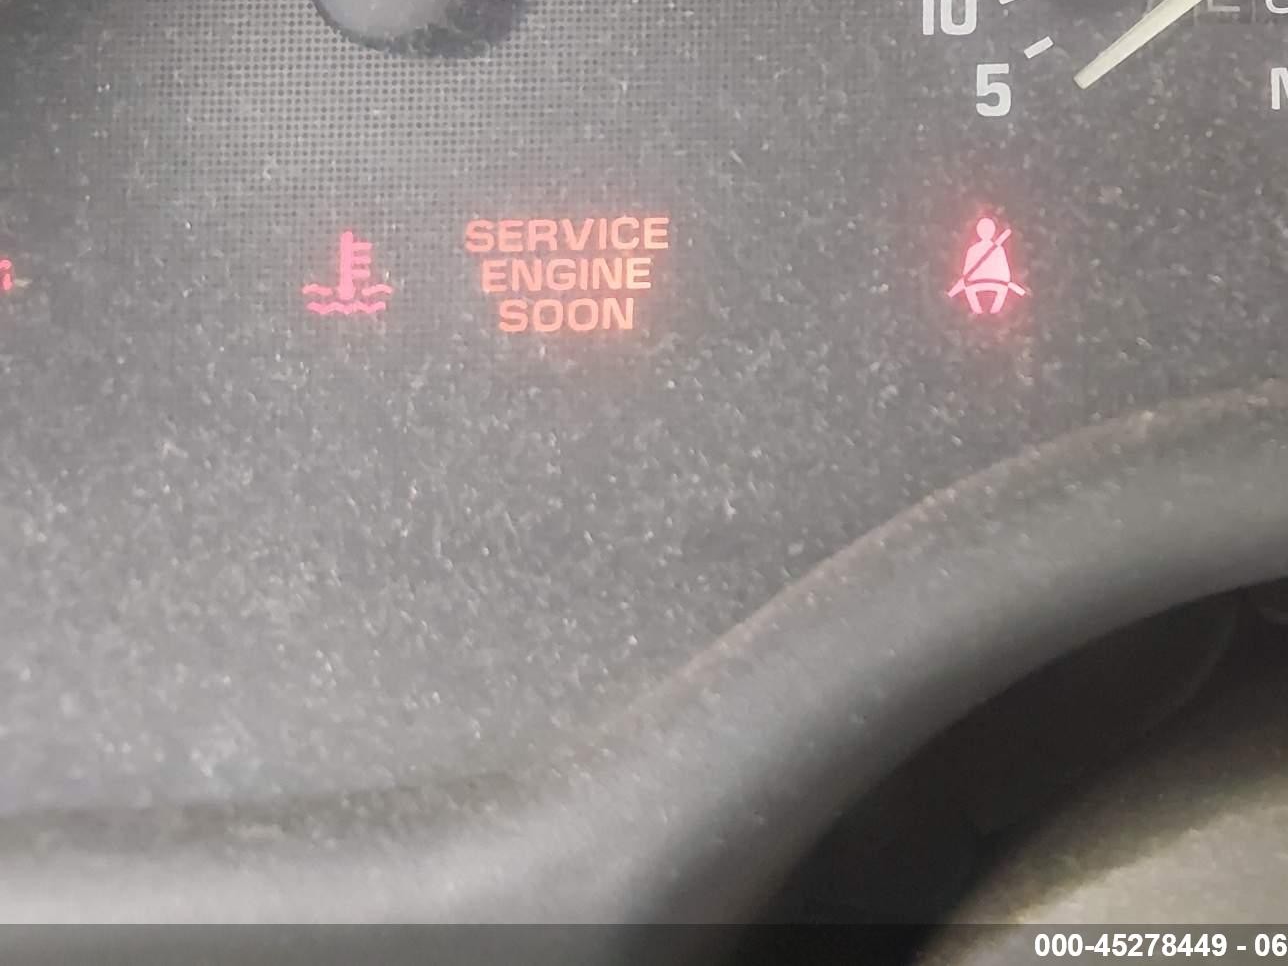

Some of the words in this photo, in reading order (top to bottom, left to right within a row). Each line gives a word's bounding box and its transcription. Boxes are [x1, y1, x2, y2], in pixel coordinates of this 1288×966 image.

[976, 64, 1011, 116] 5
[465, 217, 669, 252] SERVICE
[481, 257, 652, 293] ENGINE
[499, 298, 634, 333] SOON
